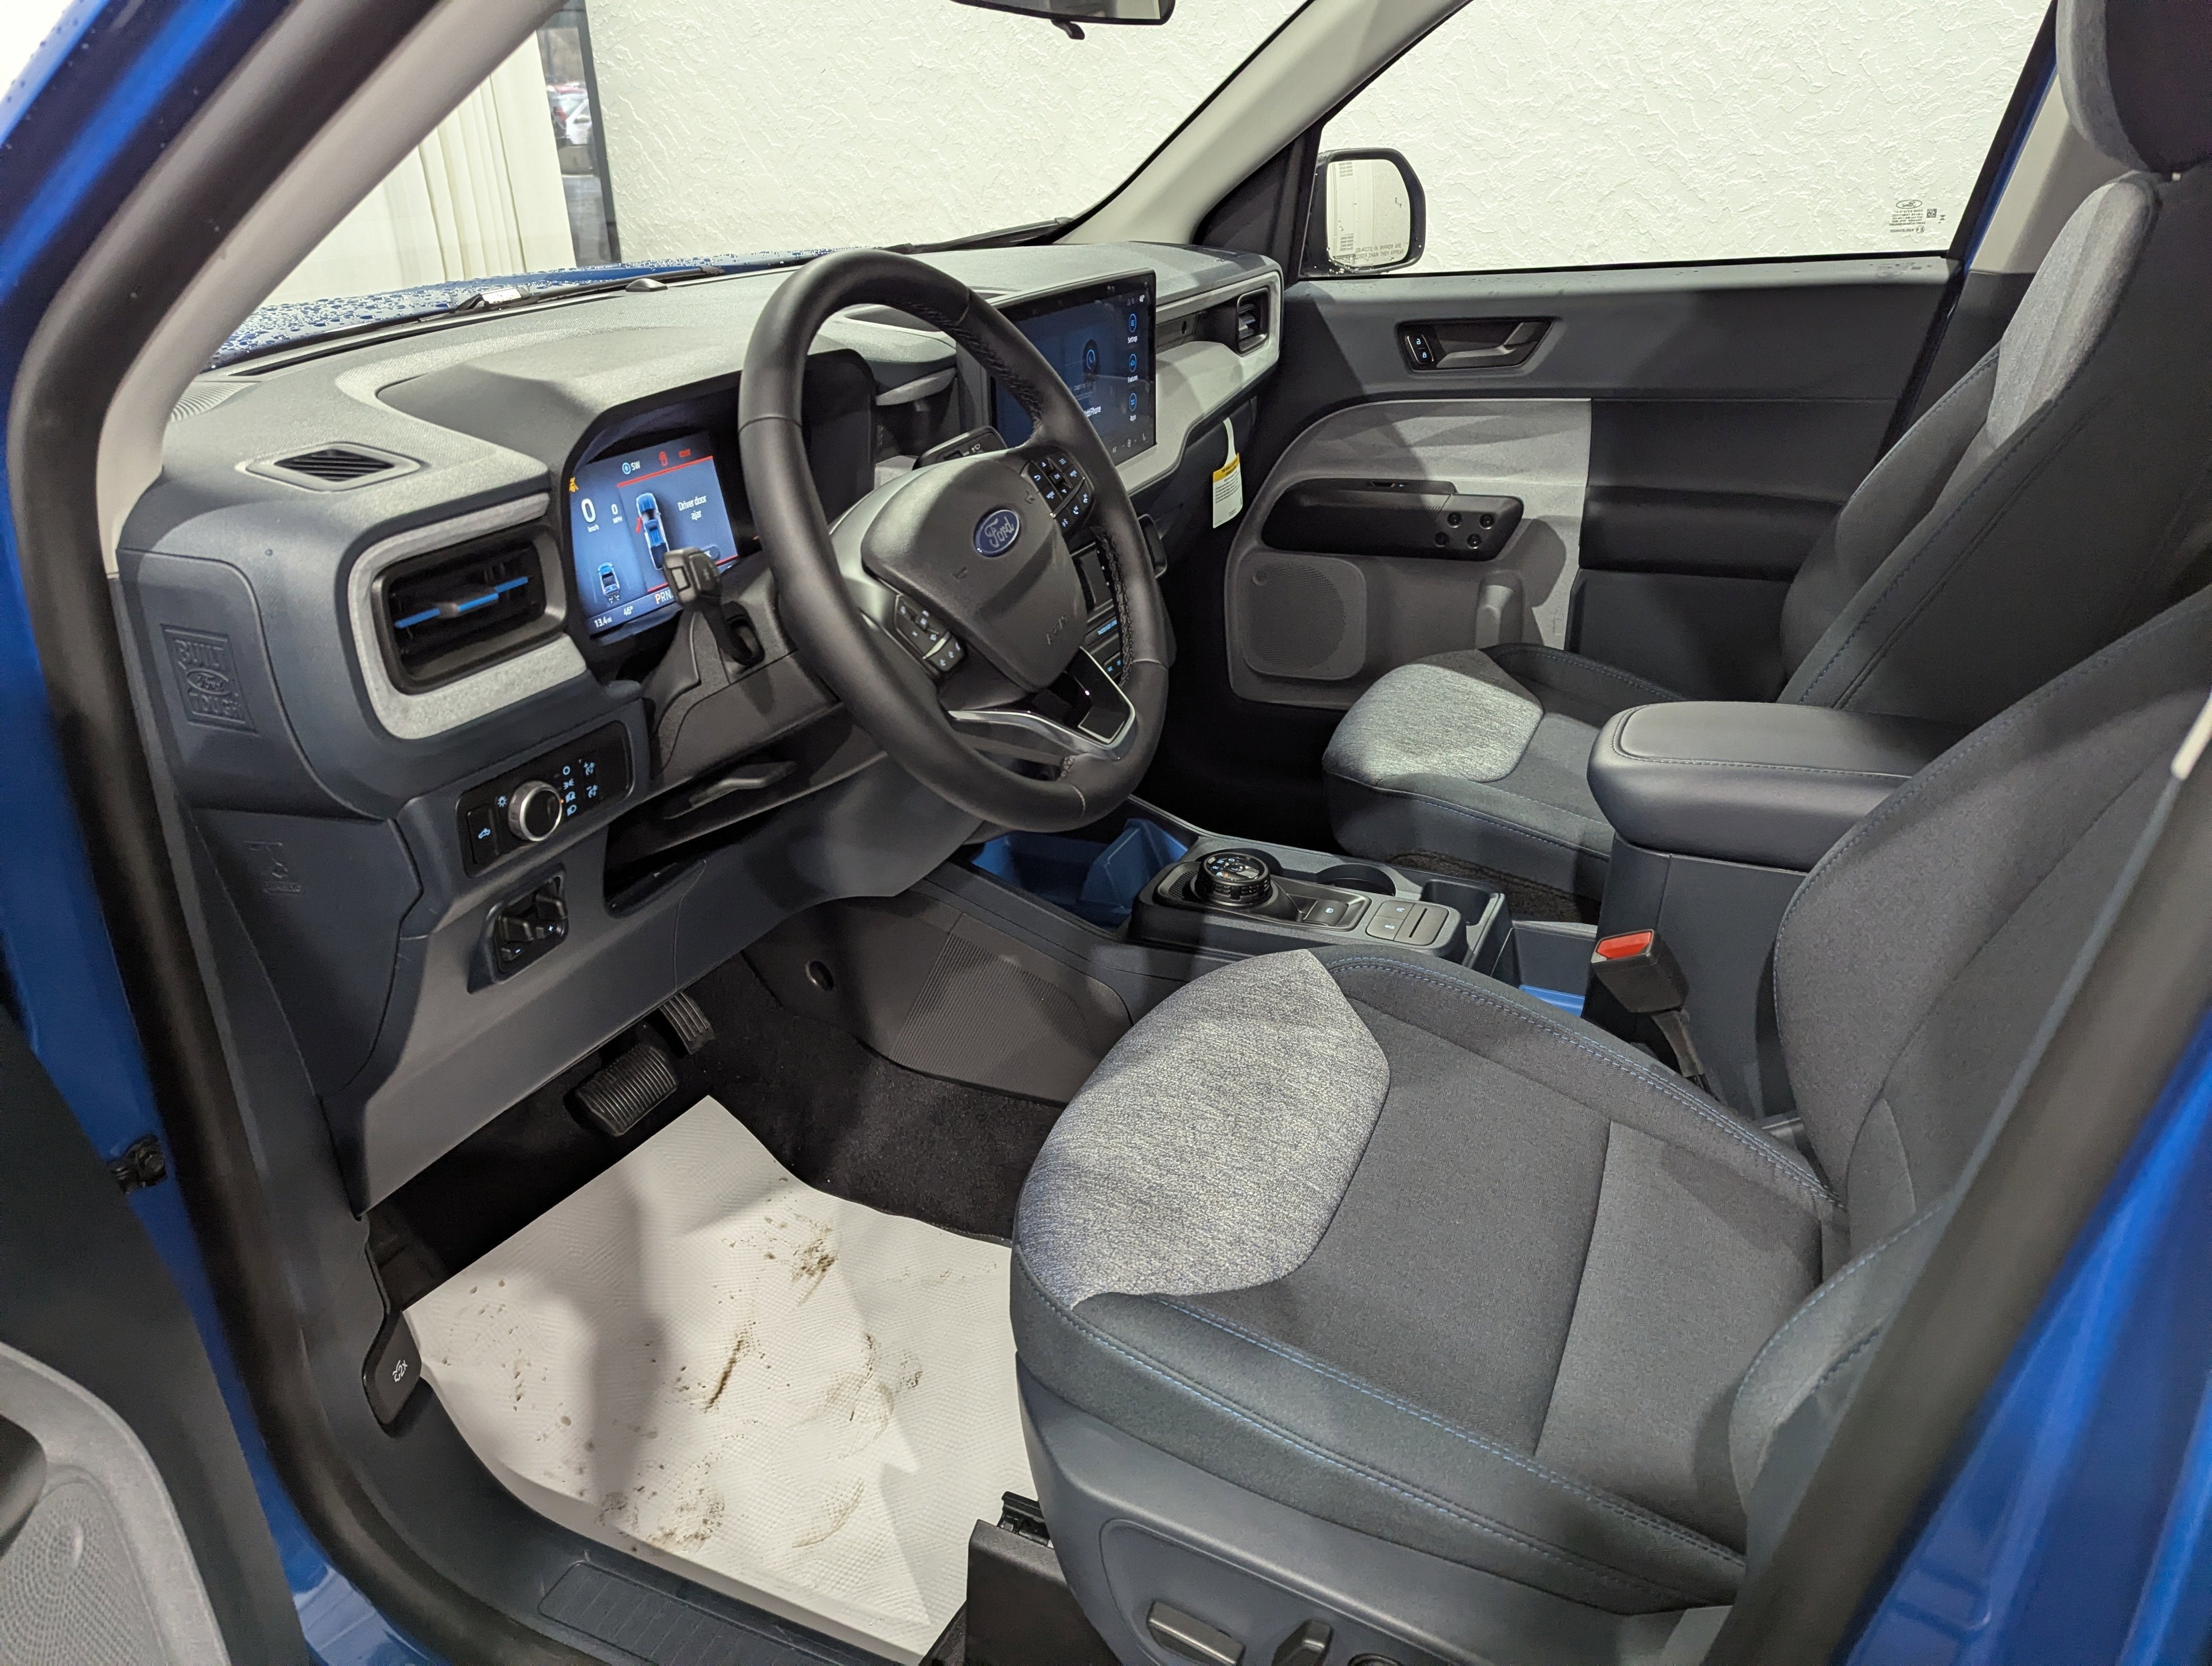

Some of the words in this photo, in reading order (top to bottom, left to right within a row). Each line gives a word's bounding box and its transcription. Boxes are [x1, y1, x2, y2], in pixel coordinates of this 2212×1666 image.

[631, 460, 640, 471] SW
[611, 503, 618, 515] 0
[678, 500, 694, 511] Driver
[694, 495, 707, 505] door
[581, 498, 596, 523] 0
[691, 510, 702, 521] ajar
[984, 516, 1015, 548] Ford
